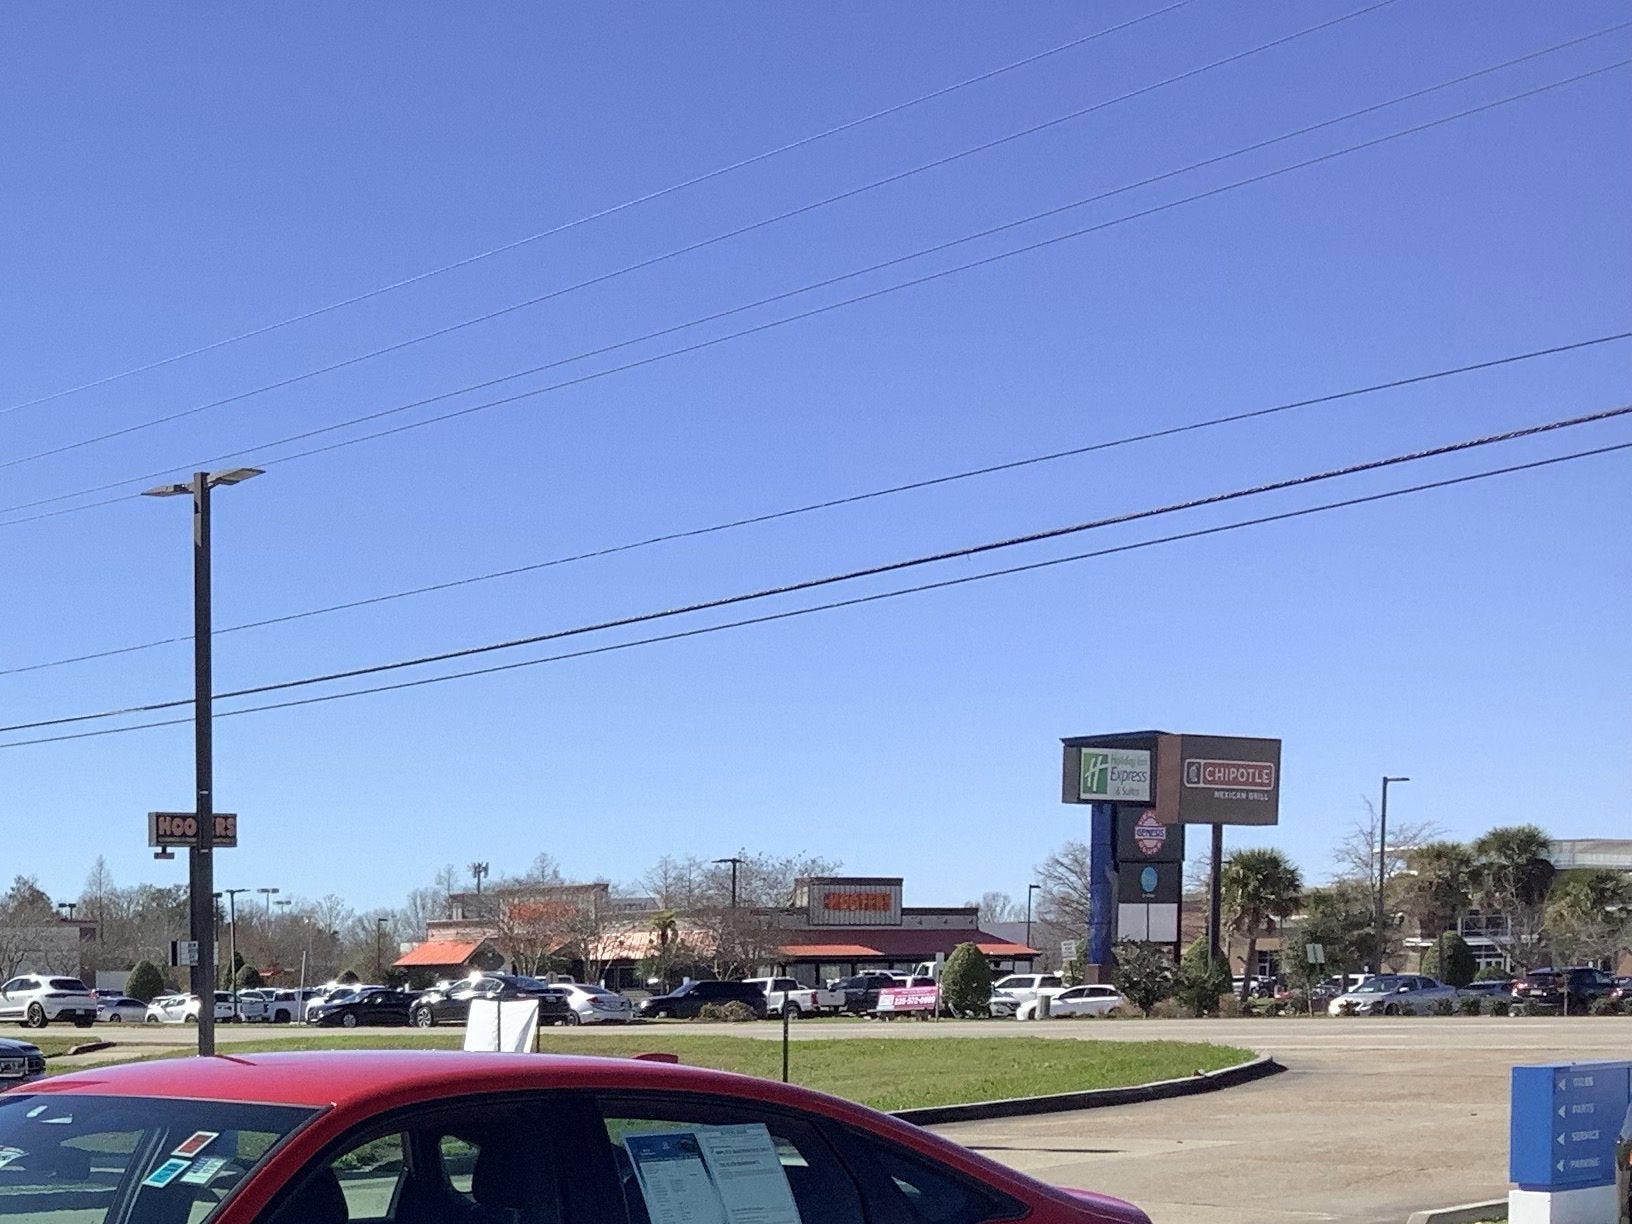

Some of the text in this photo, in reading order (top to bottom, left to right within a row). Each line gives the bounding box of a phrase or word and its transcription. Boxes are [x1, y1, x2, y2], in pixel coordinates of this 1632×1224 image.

[1110, 766, 1147, 785] Express
[1205, 766, 1270, 784] CHIPOTLE
[1214, 790, 1269, 801] MEXICAN GRILL
[158, 816, 235, 837] HOORS
[1136, 828, 1164, 837] GENESIS
[1571, 1103, 1595, 1114] PARTS
[1570, 1130, 1600, 1142] SERVICE
